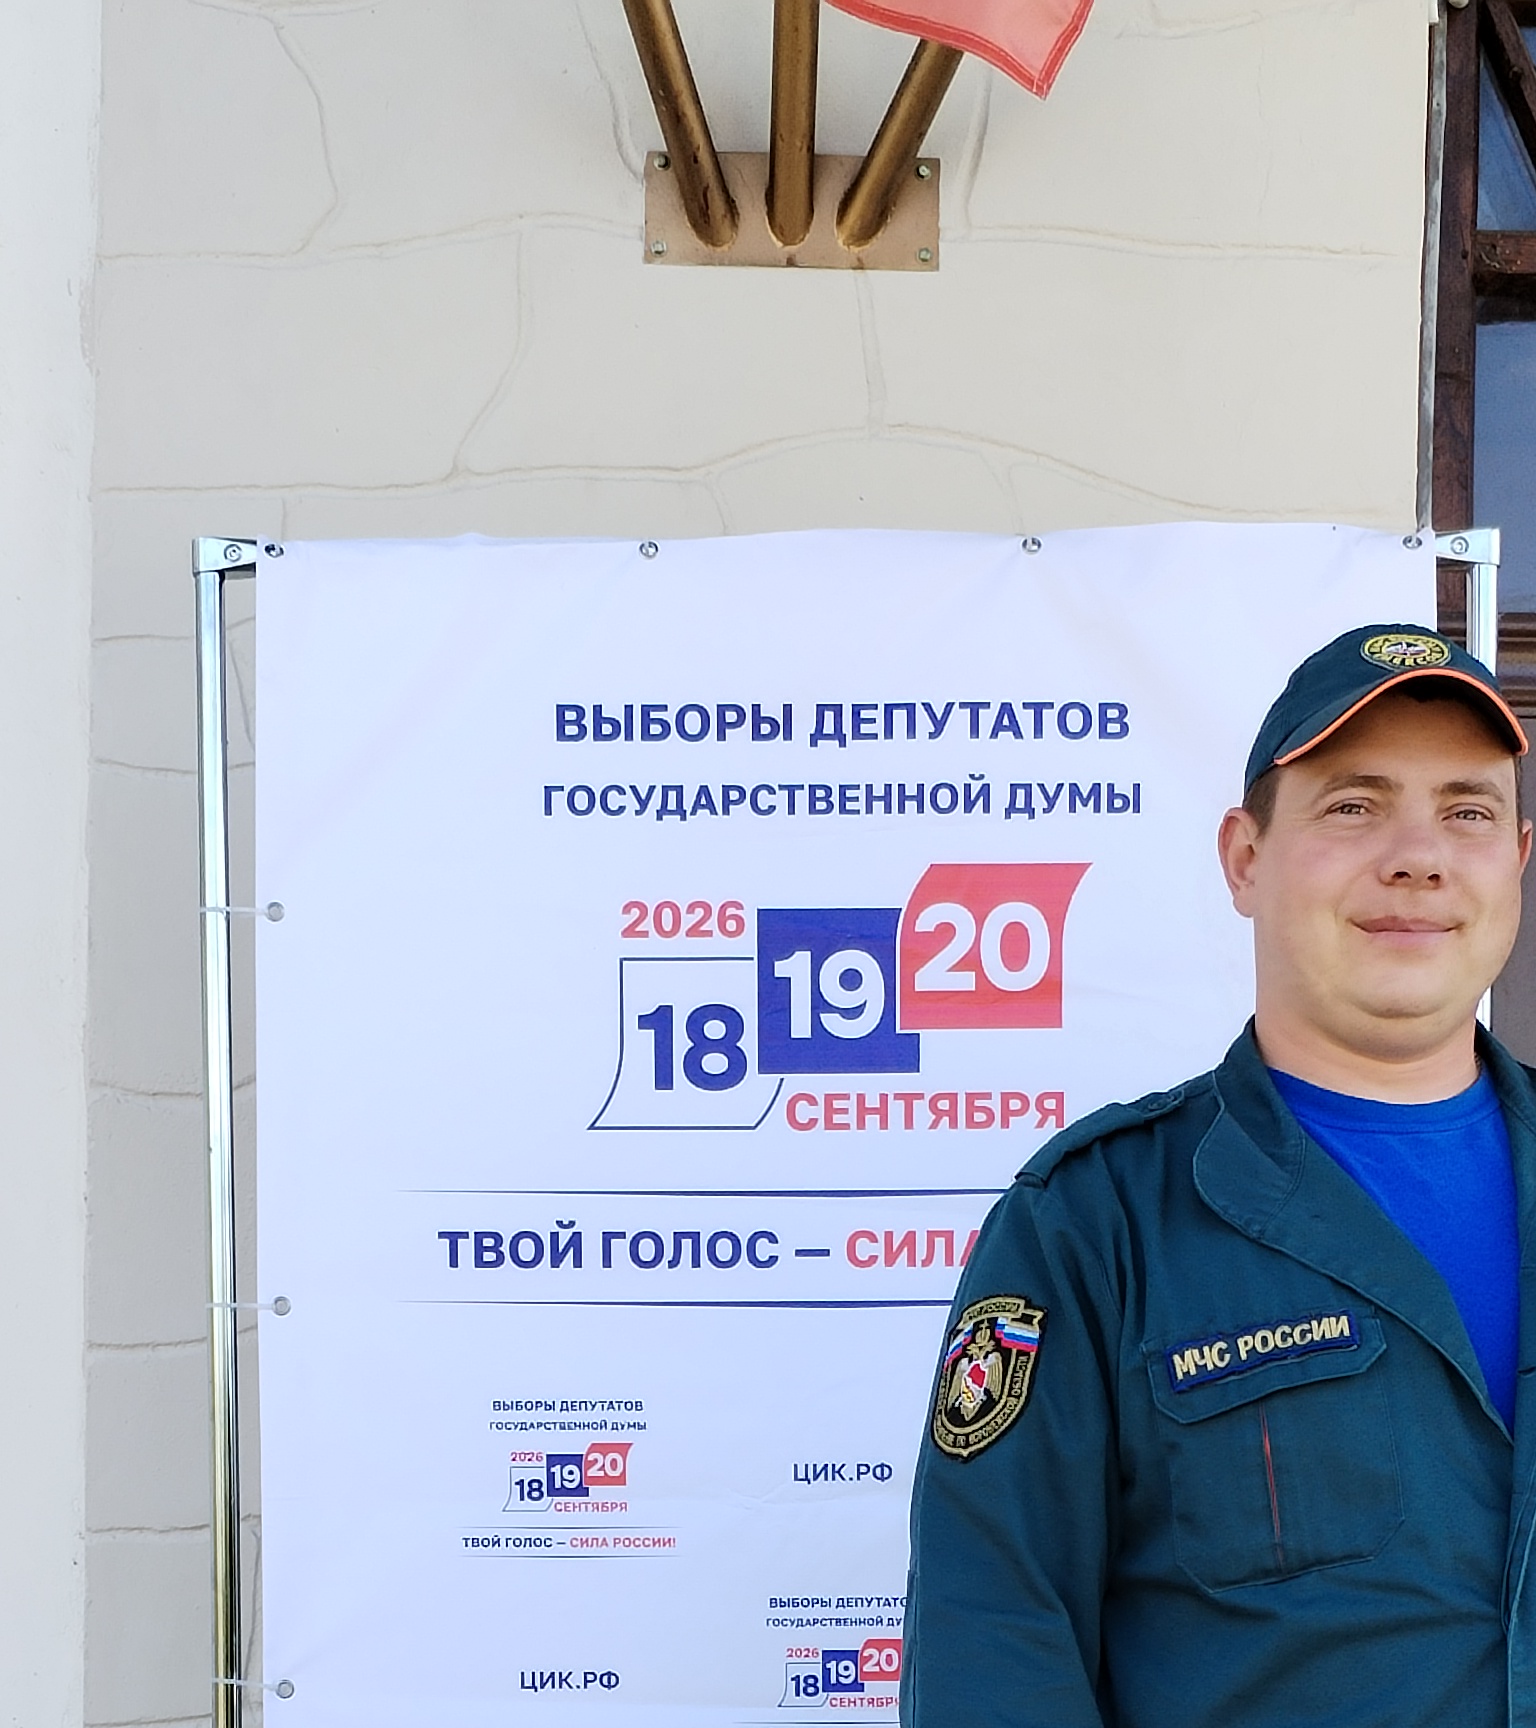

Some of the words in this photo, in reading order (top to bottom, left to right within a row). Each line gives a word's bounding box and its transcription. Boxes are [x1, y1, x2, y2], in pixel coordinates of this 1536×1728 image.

[556, 704, 792, 742] ВЫБОРЫ
[810, 702, 1129, 748] ДЕПУТАТОВ
[544, 774, 990, 821] ГОСУДАРСТВЕННОЙ
[1005, 783, 1140, 820] ДУМЫ
[621, 901, 745, 938] 2026
[638, 1004, 747, 1091] 18
[775, 950, 884, 1038] 19
[915, 902, 1051, 992] 20
[786, 1092, 1064, 1131] СЕНТЯБРЯ
[438, 1220, 582, 1268] ТВОЙ
[602, 1231, 778, 1269] ГОЛОС
[1172, 1341, 1232, 1380] МЧС
[1238, 1315, 1350, 1360] РОССИИ
[493, 1401, 555, 1411] ВЫБОРЫ
[560, 1401, 643, 1413] ДЕПУТАТОВ
[490, 1420, 607, 1431] ГОСУДАРСТВЕННОЙ
[611, 1422, 646, 1431] ДУМЫ
[510, 1452, 544, 1462] 2026
[515, 1479, 544, 1501] 18
[550, 1464, 580, 1489] 19
[586, 1453, 624, 1477] 20
[794, 1463, 892, 1484] ЦИК.РФ
[554, 1502, 627, 1512] СЕНТЯБРЯ
[462, 1535, 500, 1548] ТВОЙ
[506, 1538, 552, 1548] ГОЛОС
[570, 1537, 608, 1548] СИЛА
[613, 1538, 675, 1548] РОССИИ!
[770, 1598, 831, 1608] ВЫБОРЫ
[836, 1597, 907, 1609] ДЕПУТАТО
[767, 1616, 883, 1628] ГОСУДАРСТВЕННОЙ
[886, 1618, 902, 1627] ДУ
[786, 1648, 820, 1658] 2026
[521, 1671, 619, 1692] ЦИК.РФ
[791, 1675, 819, 1697] 18
[826, 1660, 856, 1685] 19
[862, 1649, 900, 1673] 20
